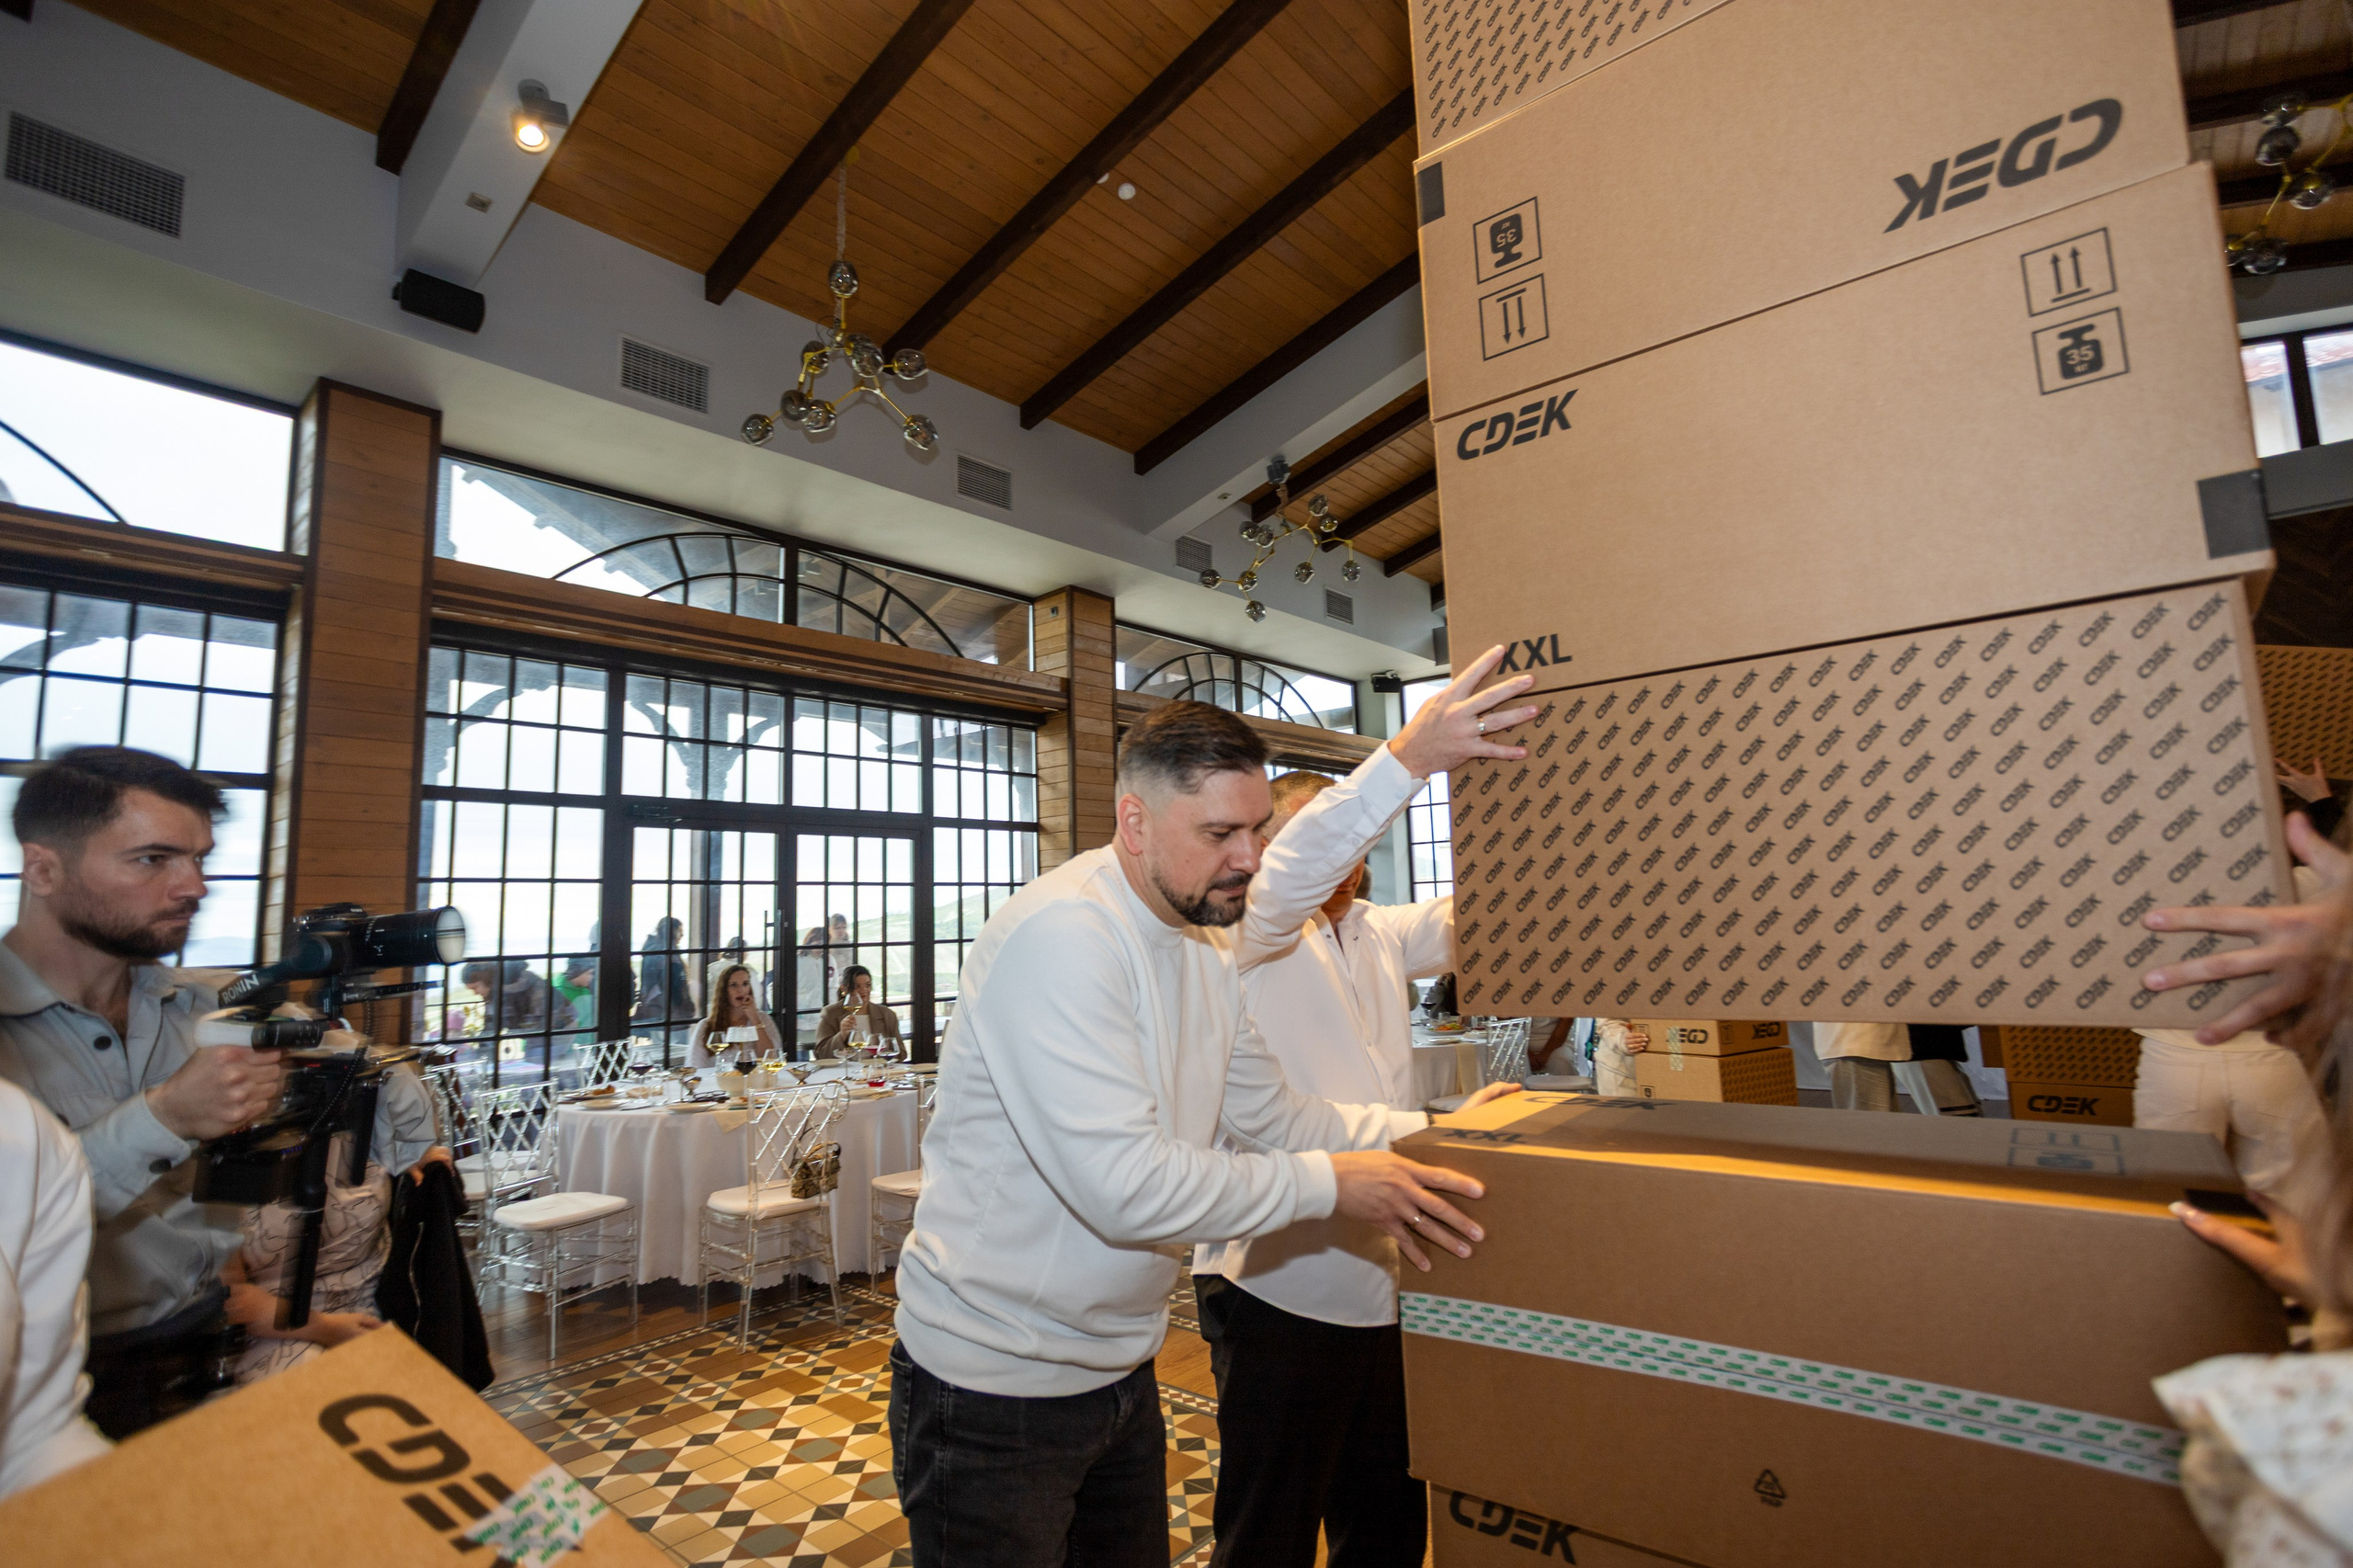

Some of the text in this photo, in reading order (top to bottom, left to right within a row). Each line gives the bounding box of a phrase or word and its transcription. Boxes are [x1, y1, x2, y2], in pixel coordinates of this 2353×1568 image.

[1882, 97, 2122, 234] CDEK
[1496, 228, 1518, 248] 35
[2065, 345, 2096, 365] 35
[1457, 388, 1580, 460] CDEK
[2188, 594, 2227, 631] CDEK
[2078, 612, 2115, 647] CDEK
[1496, 633, 1574, 676] XXL
[1980, 629, 2013, 662] CDEK
[2137, 642, 2177, 679] CDEK
[2193, 634, 2234, 672] CDEK
[1985, 665, 2019, 699] CDEK
[2033, 657, 2069, 693] CDEK
[2084, 651, 2121, 686] CDEK
[1628, 686, 1652, 714] CDEK
[1661, 680, 1686, 710] CDEK
[1939, 671, 1972, 705] CDEK
[2200, 676, 2241, 713] CDEK
[1596, 691, 1619, 720] CDEK
[1735, 701, 1763, 732] CDEK
[1773, 696, 1802, 727] CDEK
[1990, 702, 2024, 736] CDEK
[2089, 689, 2127, 725] CDEK
[1597, 722, 1621, 750] CDEK
[1899, 714, 1930, 747] CDEK
[1944, 709, 1977, 742] CDEK
[2149, 722, 2188, 759] CDEK
[2207, 717, 2248, 755] CDEK
[1536, 731, 1559, 758] CDEK
[1995, 741, 2029, 775] CDEK
[2043, 734, 2080, 770] CDEK
[2095, 729, 2133, 765] CDEK
[1539, 761, 1561, 789] CDEK
[1569, 757, 1592, 785] CDEK
[1904, 751, 1935, 783] CDEK
[1948, 746, 1982, 779] CDEK
[2213, 759, 2255, 796] CDEK
[1454, 772, 1472, 798] CDEK
[1635, 781, 1660, 810] CDEK
[1669, 777, 1695, 806] CDEK
[1704, 773, 1731, 802] CDEK
[1780, 765, 1809, 795] CDEK
[2155, 764, 2196, 801] CDEK
[1455, 801, 1474, 827] CDEK
[1823, 795, 1853, 826] CDEK
[1865, 791, 1895, 824] CDEK
[1907, 788, 1939, 820] CDEK
[1952, 783, 1986, 816] CDEK
[1573, 819, 1597, 846] CDEK
[1638, 813, 1663, 842] CDEK
[1672, 810, 1698, 839] CDEK
[1707, 806, 1734, 835] CDEK
[1745, 802, 1773, 833] CDEK
[2054, 813, 2091, 848] CDEK
[1456, 831, 1476, 856] CDEK
[1483, 827, 1505, 854] CDEK
[1513, 825, 1534, 852] CDEK
[1542, 823, 1564, 849] CDEK
[1787, 835, 1816, 865] CDEK
[1641, 846, 1665, 874] CDEK
[1710, 840, 1737, 869] CDEK
[2112, 850, 2152, 886] CDEK
[2168, 846, 2209, 883] CDEK
[2226, 844, 2270, 881] CDEK
[1485, 858, 1506, 883] CDEK
[1790, 869, 1819, 900] CDEK
[1872, 864, 1904, 896] CDEK
[1961, 858, 1995, 892] CDEK
[2009, 856, 2045, 890] CDEK
[1459, 890, 1480, 915] CDEK
[1516, 886, 1538, 913] CDEK
[1577, 882, 1601, 910] CDEK
[1643, 879, 1668, 906] CDEK
[1713, 873, 1740, 903] CDEK
[1611, 912, 1636, 940] CDEK
[1680, 909, 1706, 938] CDEK
[1755, 906, 1783, 937] CDEK
[1834, 903, 1865, 934] CDEK
[1920, 900, 1953, 932] CDEK
[2014, 895, 2051, 929] CDEK
[1488, 918, 1510, 944] CDEK
[1548, 915, 1571, 942] CDEK
[1461, 949, 1483, 974] CDEK
[1550, 947, 1573, 973] CDEK
[1614, 945, 1639, 972] CDEK
[1682, 943, 1709, 971] CDEK
[1757, 941, 1787, 971] CDEK
[1837, 939, 1869, 971] CDEK
[1925, 937, 1958, 970] CDEK
[1971, 937, 2006, 969] CDEK
[2070, 934, 2108, 969] CDEK
[222, 972, 260, 1005] RONIN
[1491, 978, 1513, 1005] CDEK
[1552, 978, 1575, 1005] CDEK
[1583, 978, 1608, 1006] CDEK
[1650, 977, 1676, 1006] CDEK
[1722, 977, 1749, 1006] CDEK
[1841, 976, 1872, 1007] CDEK
[1884, 975, 1916, 1007] CDEK
[2024, 975, 2061, 1009] CDEK
[2075, 974, 2114, 1009] CDEK
[1665, 1028, 1709, 1045] CDE
[2027, 1094, 2100, 1117] CDEK
[1443, 1129, 1526, 1144] XXL
[1449, 1490, 1577, 1566] CDEK
